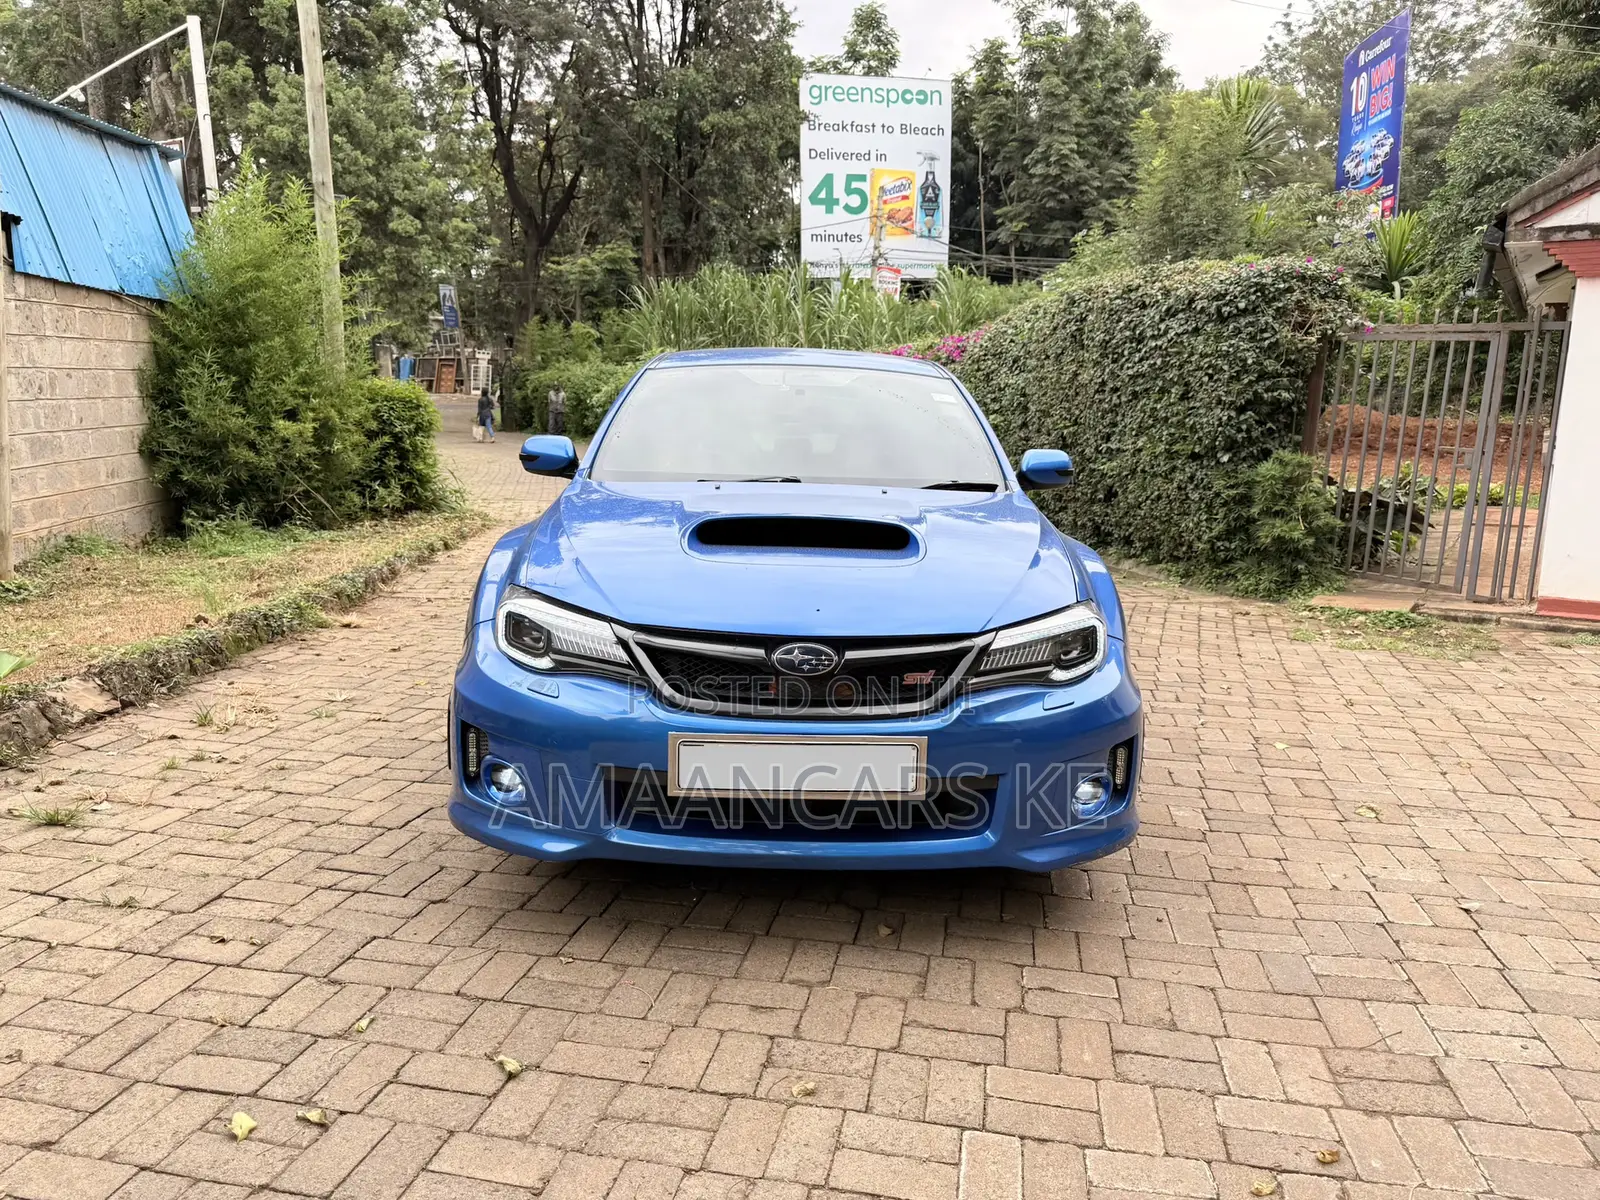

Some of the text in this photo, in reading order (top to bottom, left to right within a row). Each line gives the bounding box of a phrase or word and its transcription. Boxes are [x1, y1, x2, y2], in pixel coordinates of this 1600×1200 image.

[1366, 37, 1392, 62] Carrefour
[1371, 53, 1396, 91] WIN
[809, 84, 942, 107] greenspoon
[1351, 72, 1368, 116] 10
[1369, 82, 1393, 118] BIG!
[808, 119, 945, 136] Breakfast to Bleach
[808, 148, 887, 162] Delivered in
[808, 173, 869, 215] 45
[881, 181, 912, 196] eetabix
[810, 230, 863, 243] minutes
